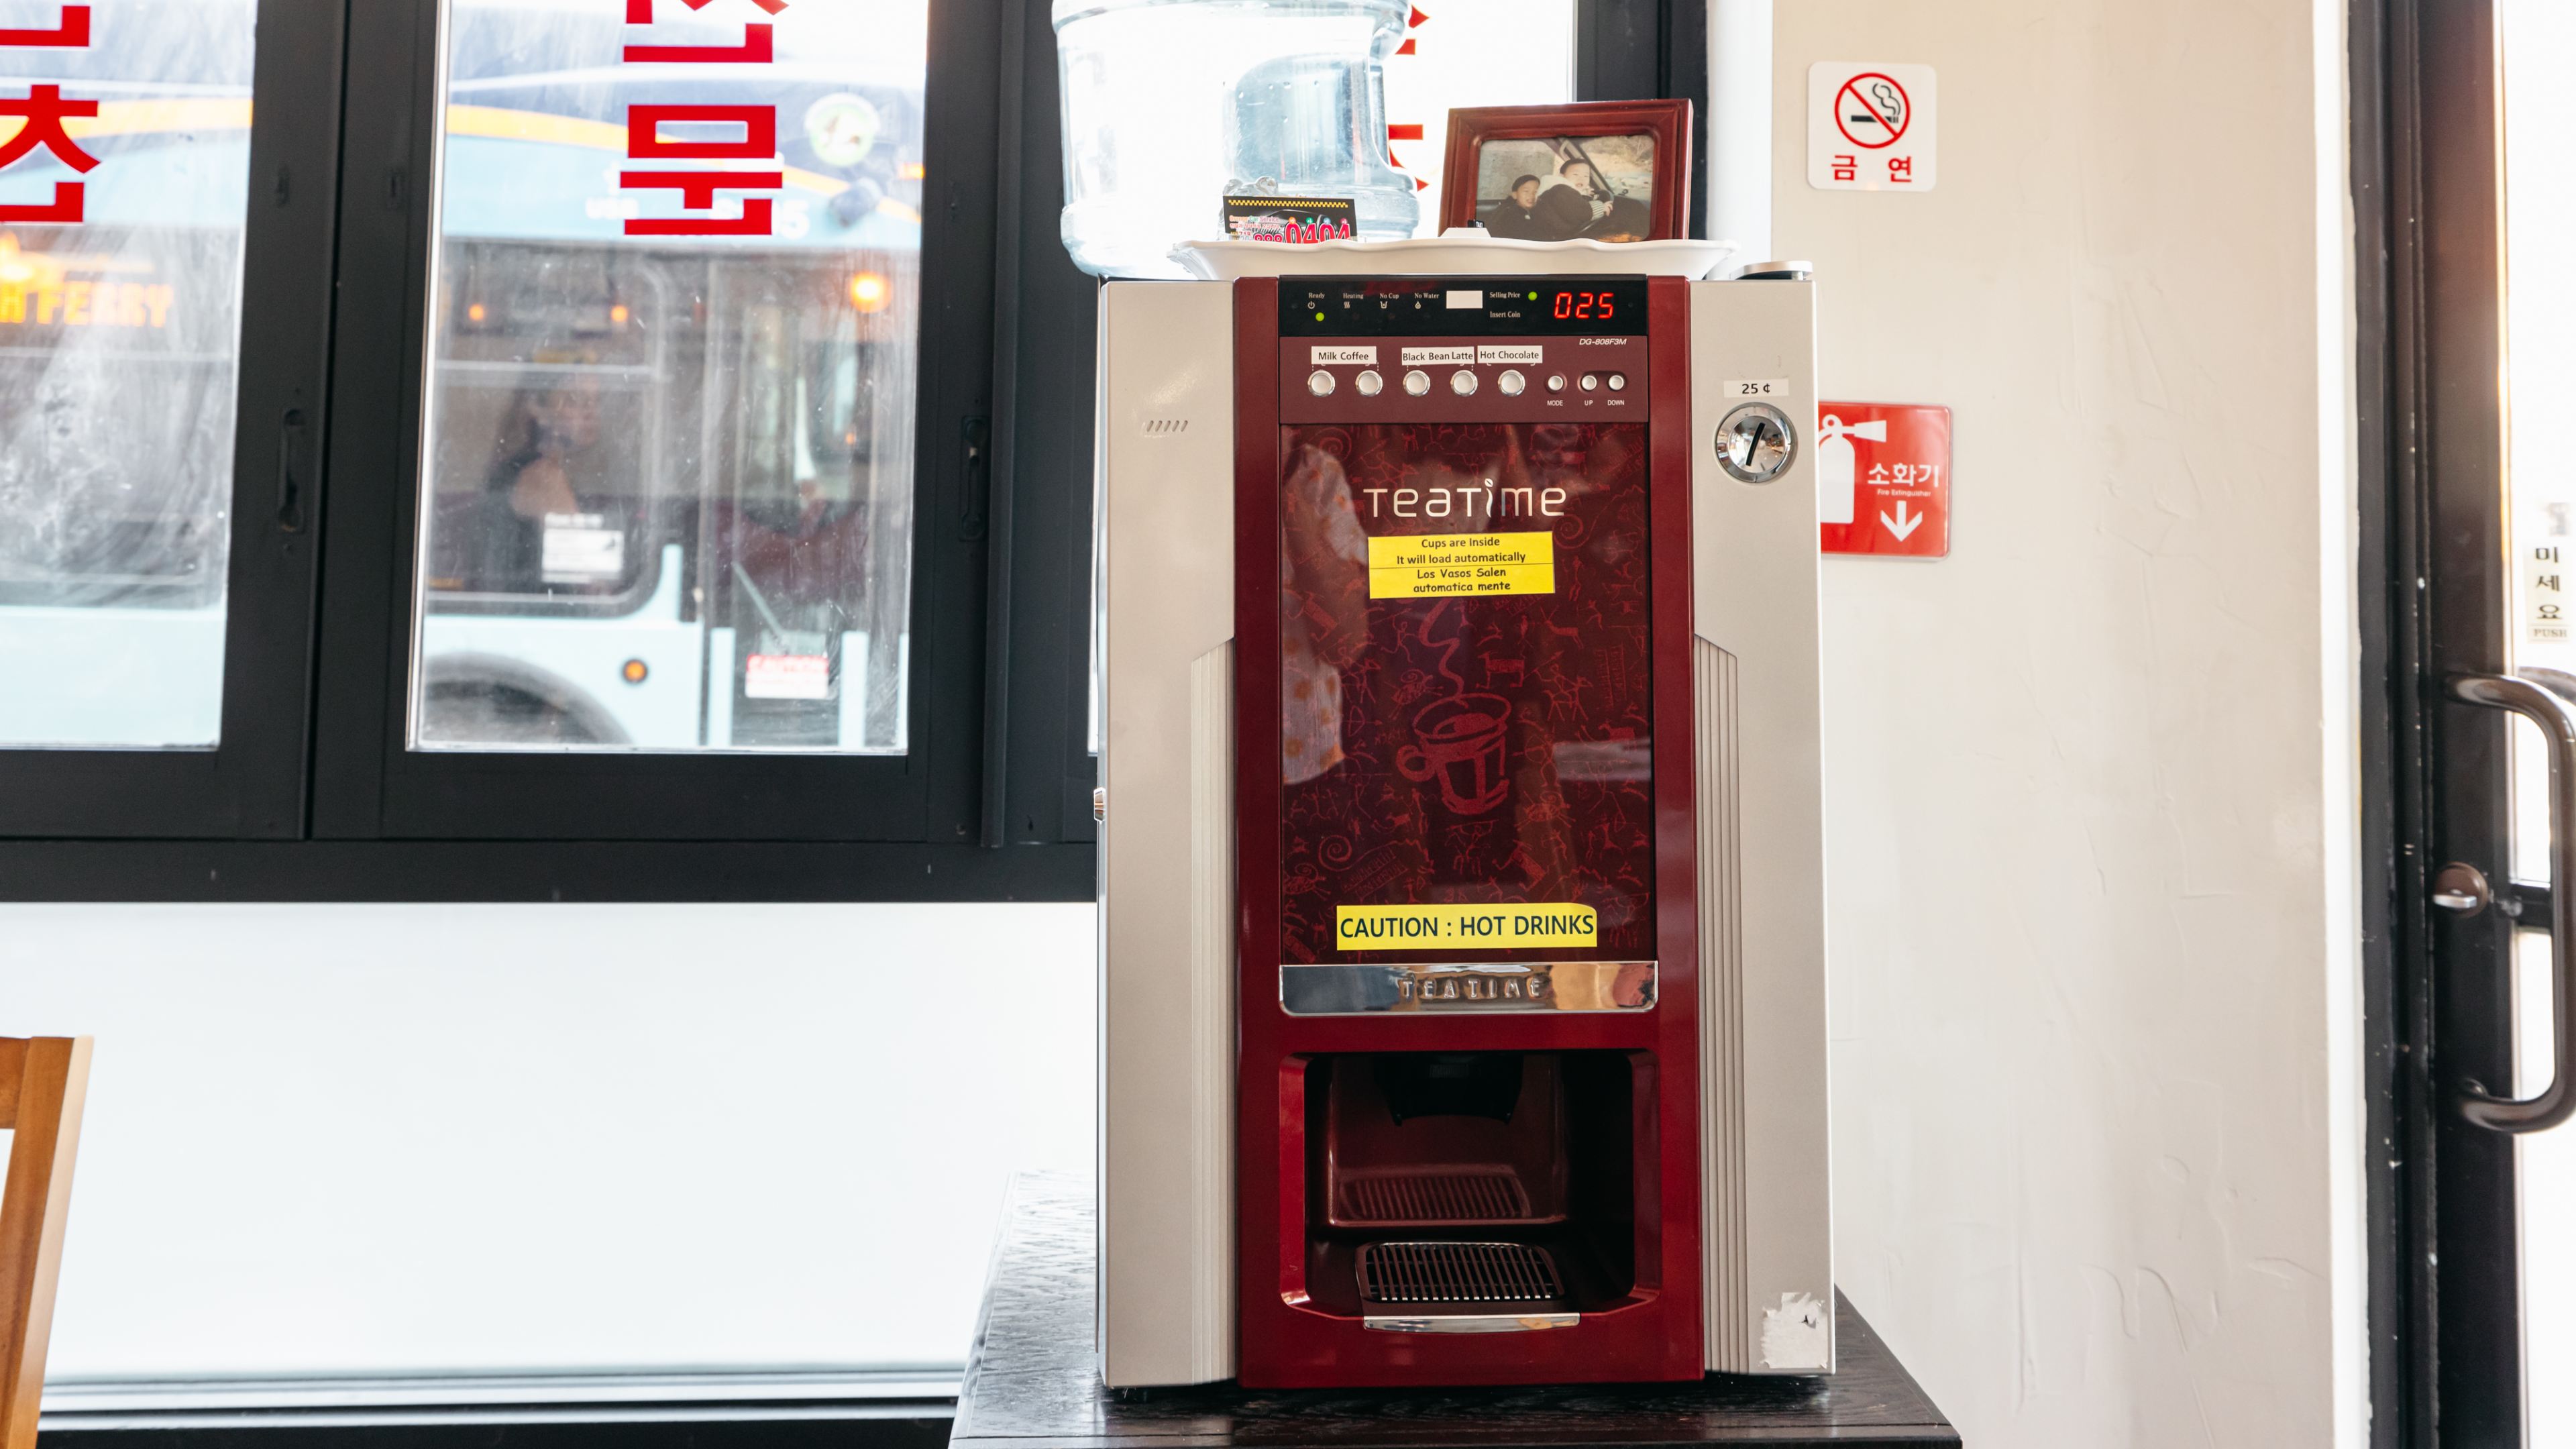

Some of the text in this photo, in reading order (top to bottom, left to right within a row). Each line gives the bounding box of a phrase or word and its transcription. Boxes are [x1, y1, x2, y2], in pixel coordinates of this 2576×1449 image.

[1489, 291, 1507, 299] Selling
[37, 280, 173, 327] FERRY
[1553, 292, 1614, 319] 025
[1318, 352, 1369, 360] Milk Coffee
[1403, 351, 1473, 361] Black Bean Latte
[1480, 350, 1540, 359] Hot Chocolate
[1741, 383, 1770, 394] 25 ¢
[1868, 462, 1939, 488] 소화기
[1877, 488, 1933, 497] Fire Extinguisher
[1421, 537, 1500, 548] Cups are Inside
[1397, 551, 1526, 565] It will load automatically
[1417, 567, 1507, 580] Los Vasos Salen
[1413, 581, 1511, 593] automatica mente
[2535, 547, 2562, 619] 미세요
[2534, 629, 2567, 637] PUSH
[1340, 914, 1594, 938] CAUTION : HOT DRINKS
[1403, 979, 1543, 999] TEATIME
